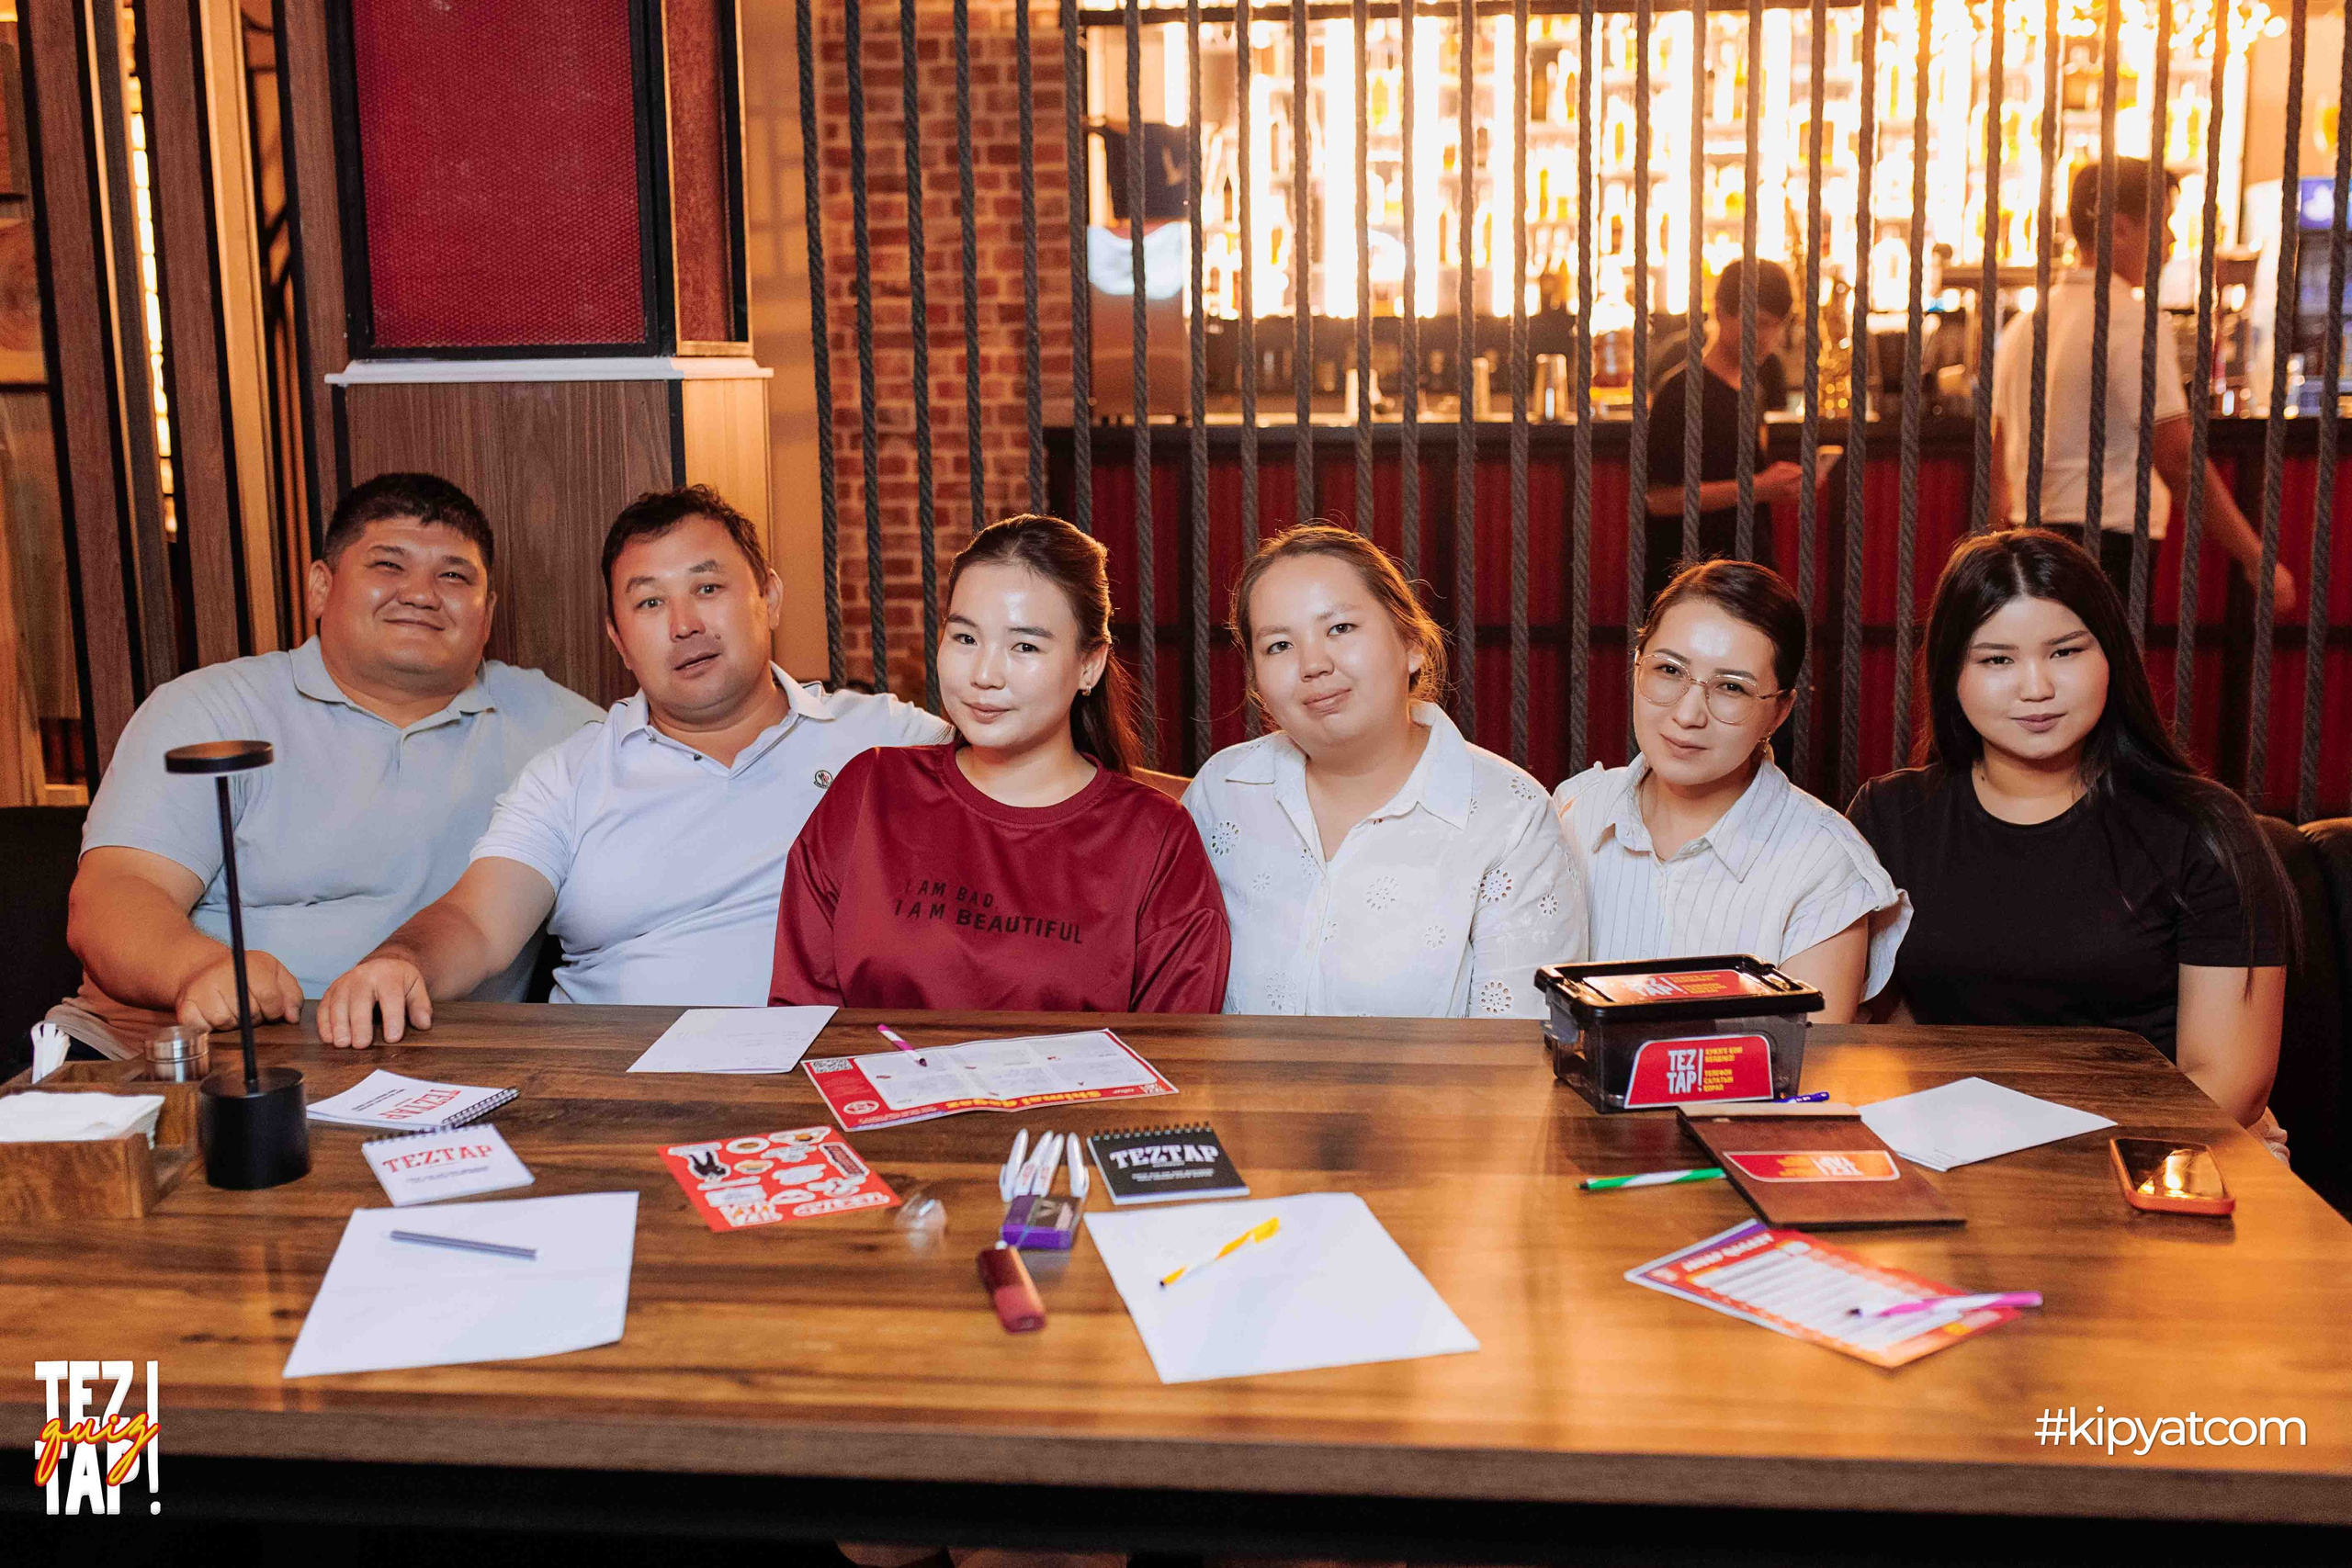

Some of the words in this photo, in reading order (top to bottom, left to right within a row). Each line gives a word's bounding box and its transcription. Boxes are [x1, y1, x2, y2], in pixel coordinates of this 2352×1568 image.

[919, 879, 947, 897] AM
[894, 899, 903, 917] I
[908, 901, 946, 919] AM
[956, 908, 1083, 944] BEAUTIFUL
[1668, 1048, 1697, 1072] TEZ
[381, 1145, 493, 1173] TEZTAP
[1109, 1145, 1219, 1169] TEZTAP
